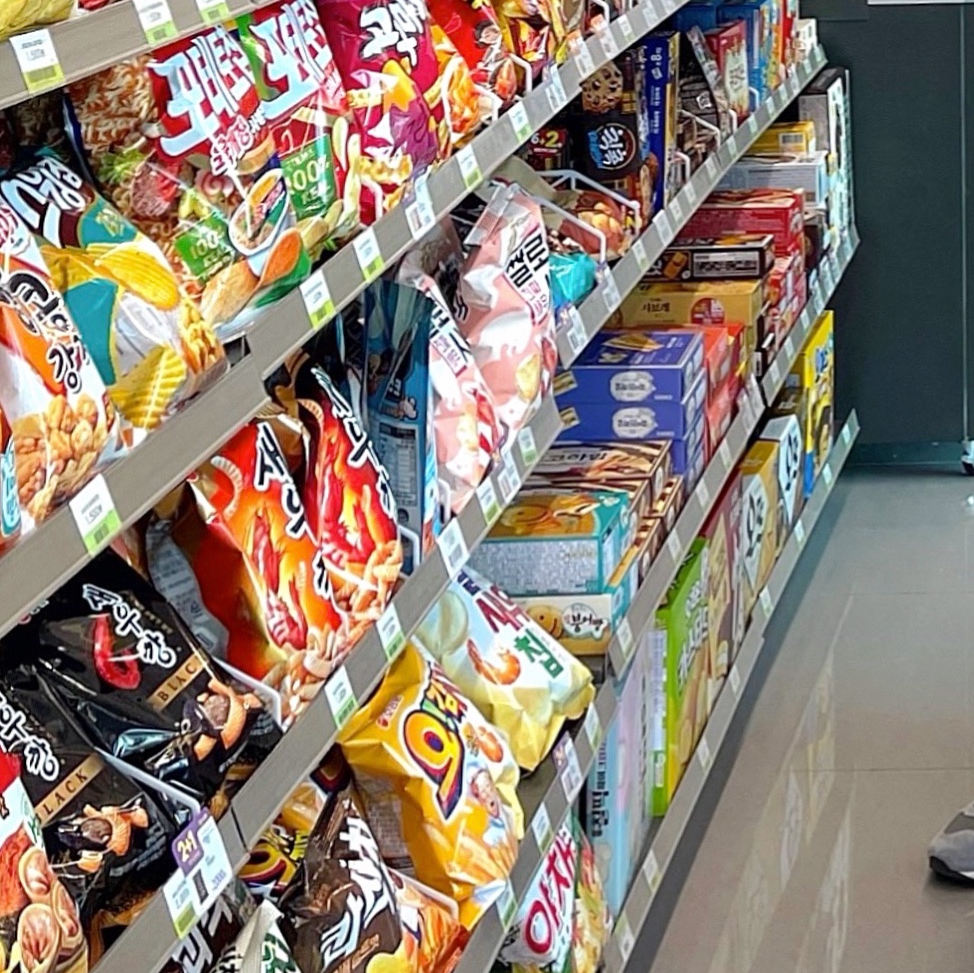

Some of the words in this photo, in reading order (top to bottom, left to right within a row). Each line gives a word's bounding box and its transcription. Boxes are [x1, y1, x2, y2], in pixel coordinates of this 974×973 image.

[82, 582, 178, 669] 새우깡
[152, 650, 202, 710] BLAC
[39, 761, 92, 822] LACK
